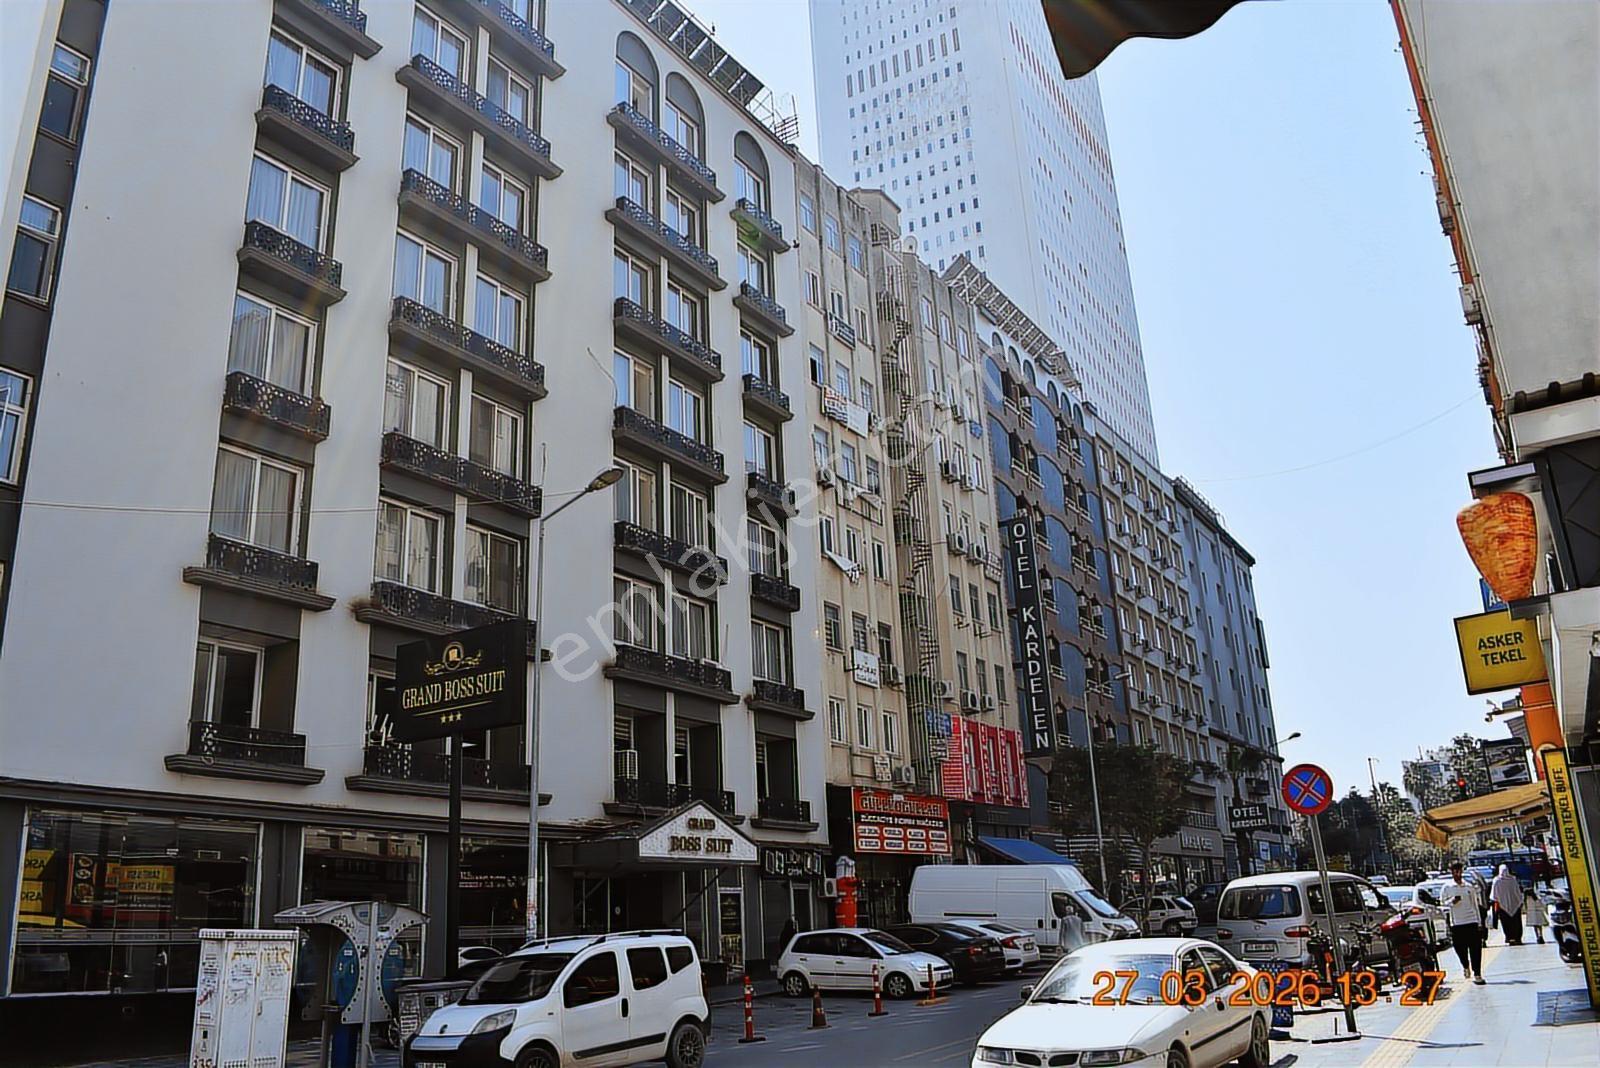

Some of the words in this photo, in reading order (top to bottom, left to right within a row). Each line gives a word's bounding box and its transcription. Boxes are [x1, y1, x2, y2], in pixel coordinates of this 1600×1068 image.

[1013, 523, 1032, 590] OTEL
[1478, 631, 1524, 651] ASKER
[1481, 648, 1527, 666] TEKEL
[402, 683, 442, 709] GRAND
[444, 677, 475, 701] BOSS
[476, 670, 506, 695] SUIT
[1022, 606, 1050, 749] KARDELEN
[1233, 806, 1263, 817] OTEL
[1559, 794, 1572, 826] TEKEL
[687, 818, 716, 830] GRAND
[670, 836, 702, 852] BOSS
[705, 838, 734, 853] SUIT
[1565, 827, 1580, 859] ASKER
